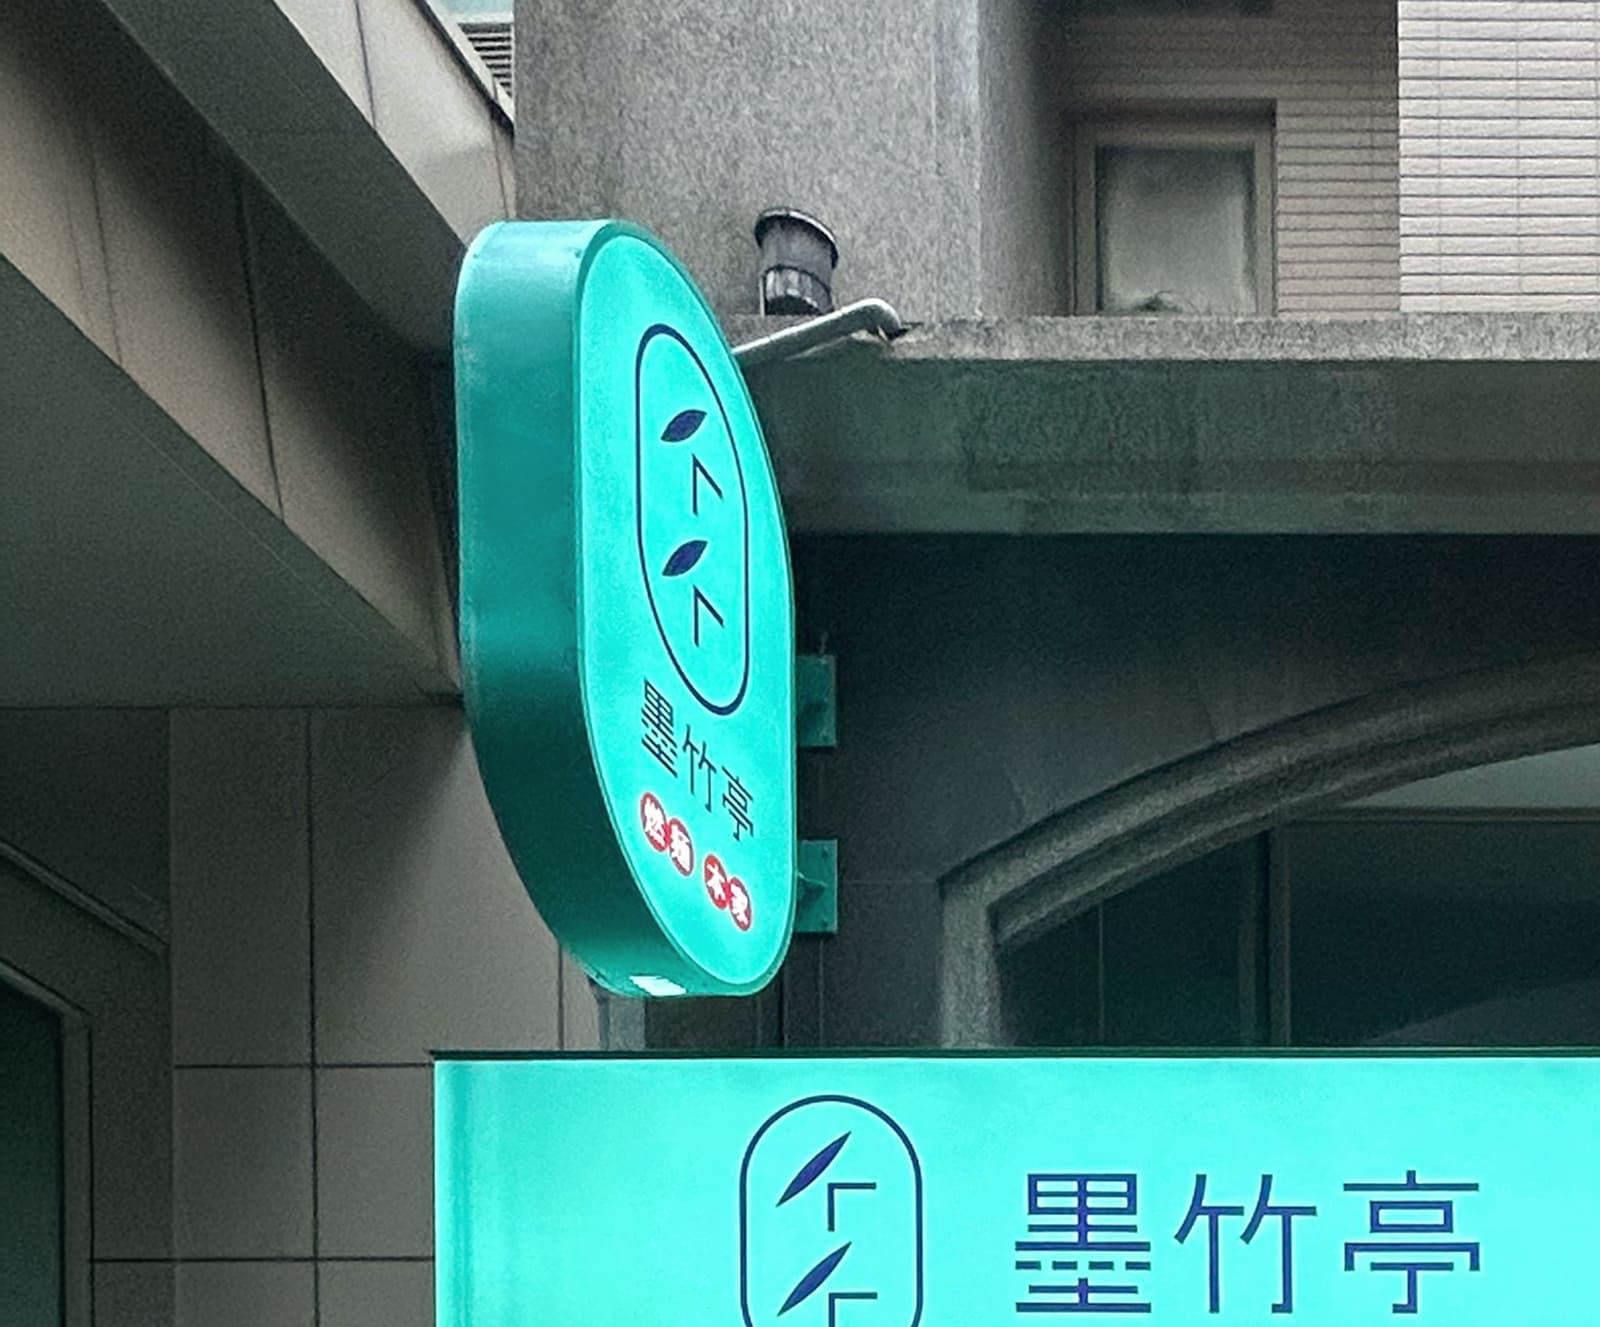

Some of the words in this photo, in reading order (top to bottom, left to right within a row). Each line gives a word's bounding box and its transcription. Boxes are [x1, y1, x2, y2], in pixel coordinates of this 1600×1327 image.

[641, 677, 754, 843] 墨竹亭
[1015, 1170, 1480, 1314] 墨竹亭
